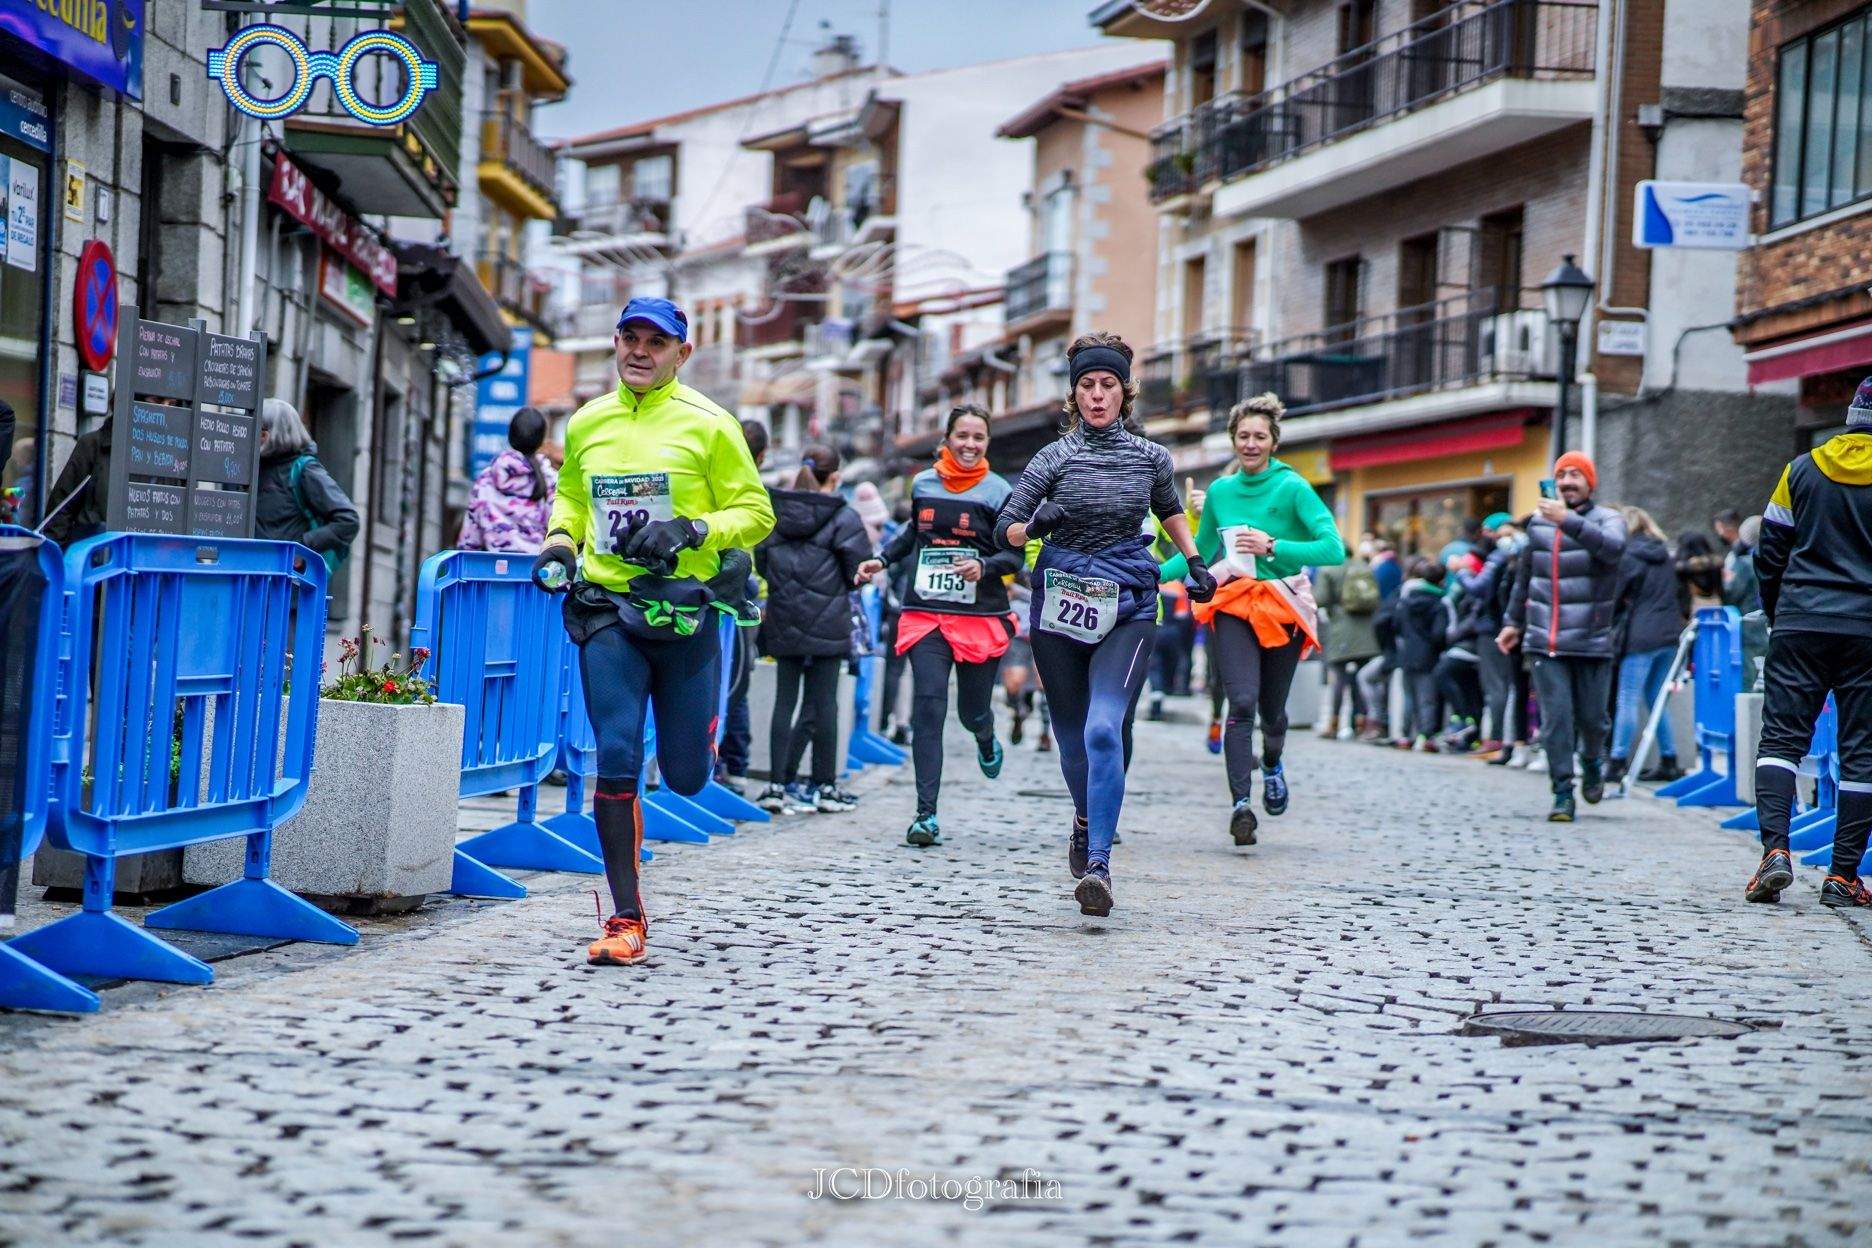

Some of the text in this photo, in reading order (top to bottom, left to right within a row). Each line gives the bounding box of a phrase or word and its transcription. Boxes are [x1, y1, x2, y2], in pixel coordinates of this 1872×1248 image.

[595, 477, 619, 485] CARRERA
[928, 573, 965, 591] 1153
[1057, 599, 1099, 630] 226
